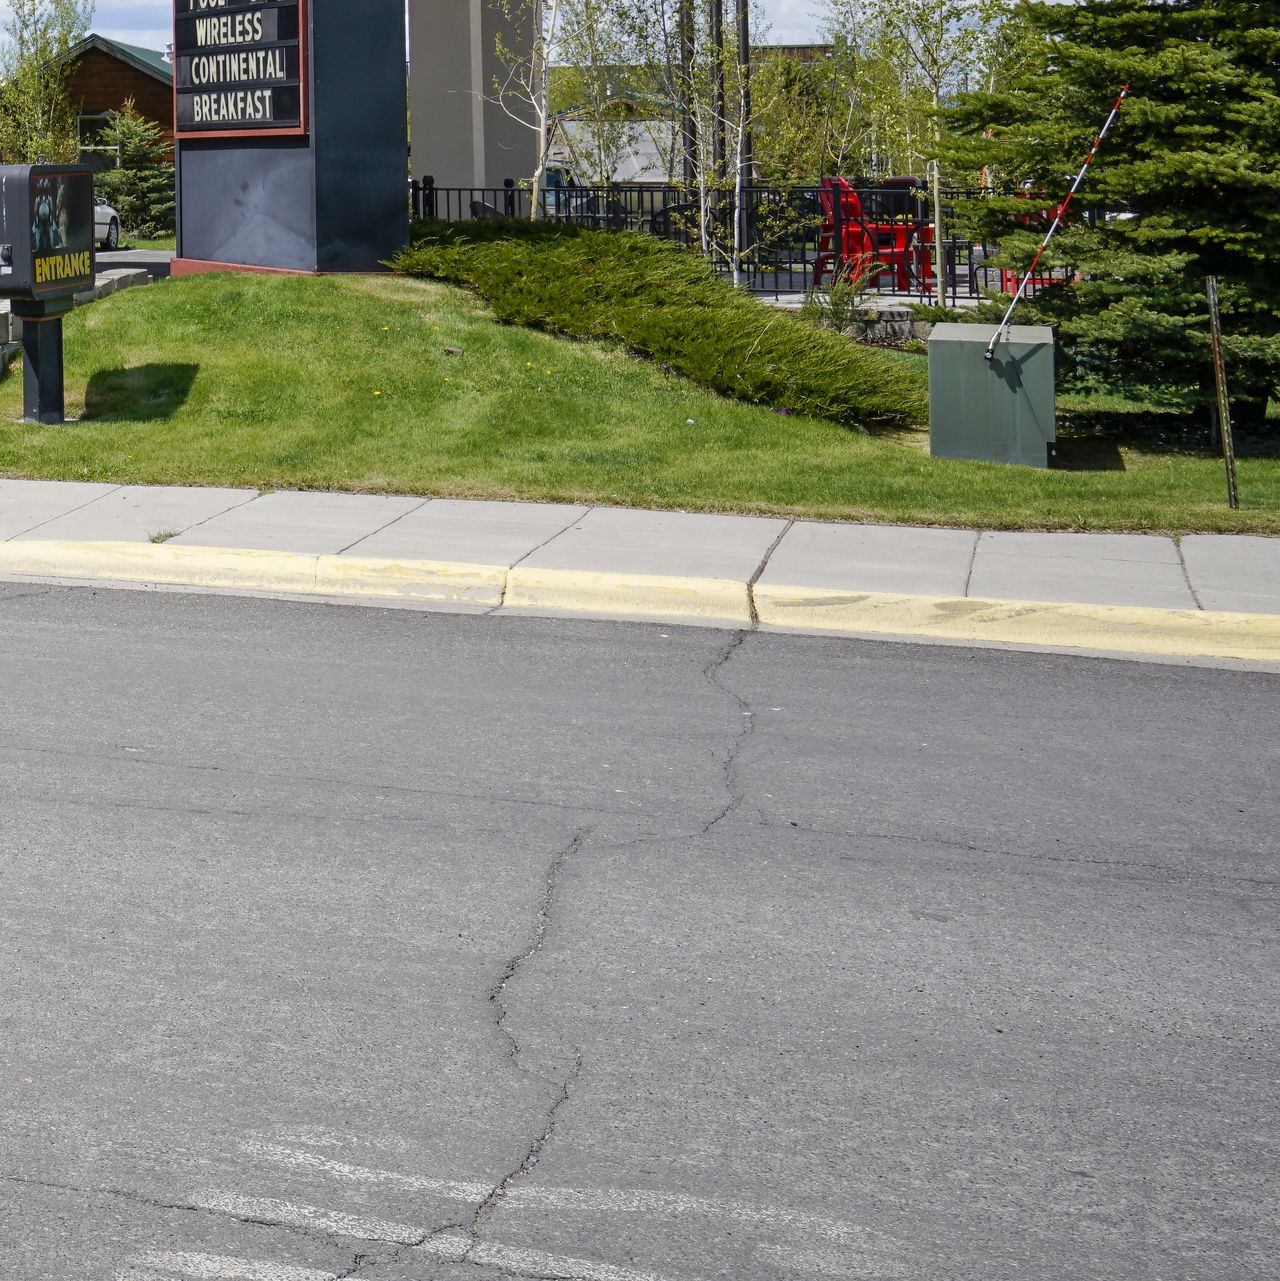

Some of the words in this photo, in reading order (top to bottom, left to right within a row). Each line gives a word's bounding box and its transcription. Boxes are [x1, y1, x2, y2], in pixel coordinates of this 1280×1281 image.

[195, 12, 262, 47] WIRELESS
[191, 49, 284, 84] CONTINENTAL
[193, 90, 272, 122] BREAKFAST
[35, 251, 90, 283] ENTRANCE
